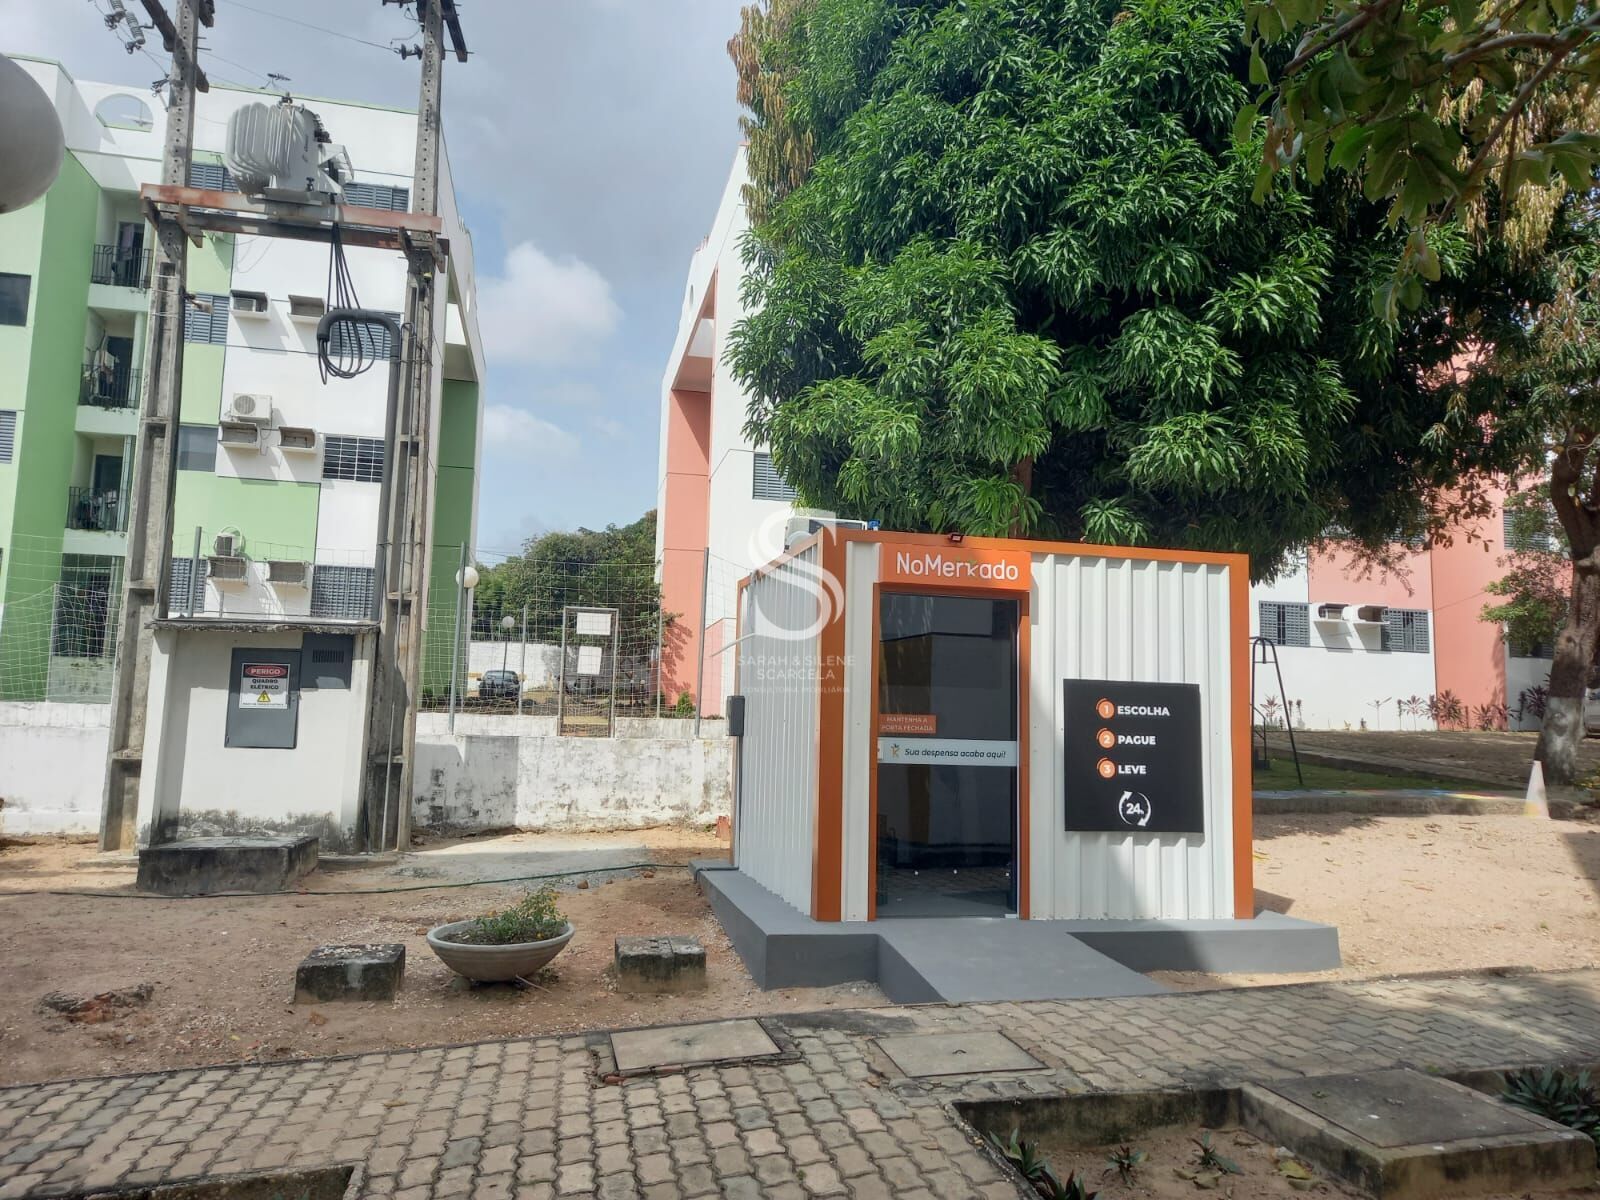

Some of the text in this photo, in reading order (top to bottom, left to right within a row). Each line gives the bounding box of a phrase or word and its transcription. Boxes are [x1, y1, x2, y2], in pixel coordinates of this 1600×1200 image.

[896, 551, 1018, 580] NoMerkado
[1104, 705, 1170, 716] 1 ESCOLHA
[903, 724, 933, 732] FECHADA
[1104, 734, 1156, 745] 2 PAGUE
[904, 748, 1006, 759] Sua despensa acaba aqui!
[1104, 764, 1147, 774] 3 LEVE
